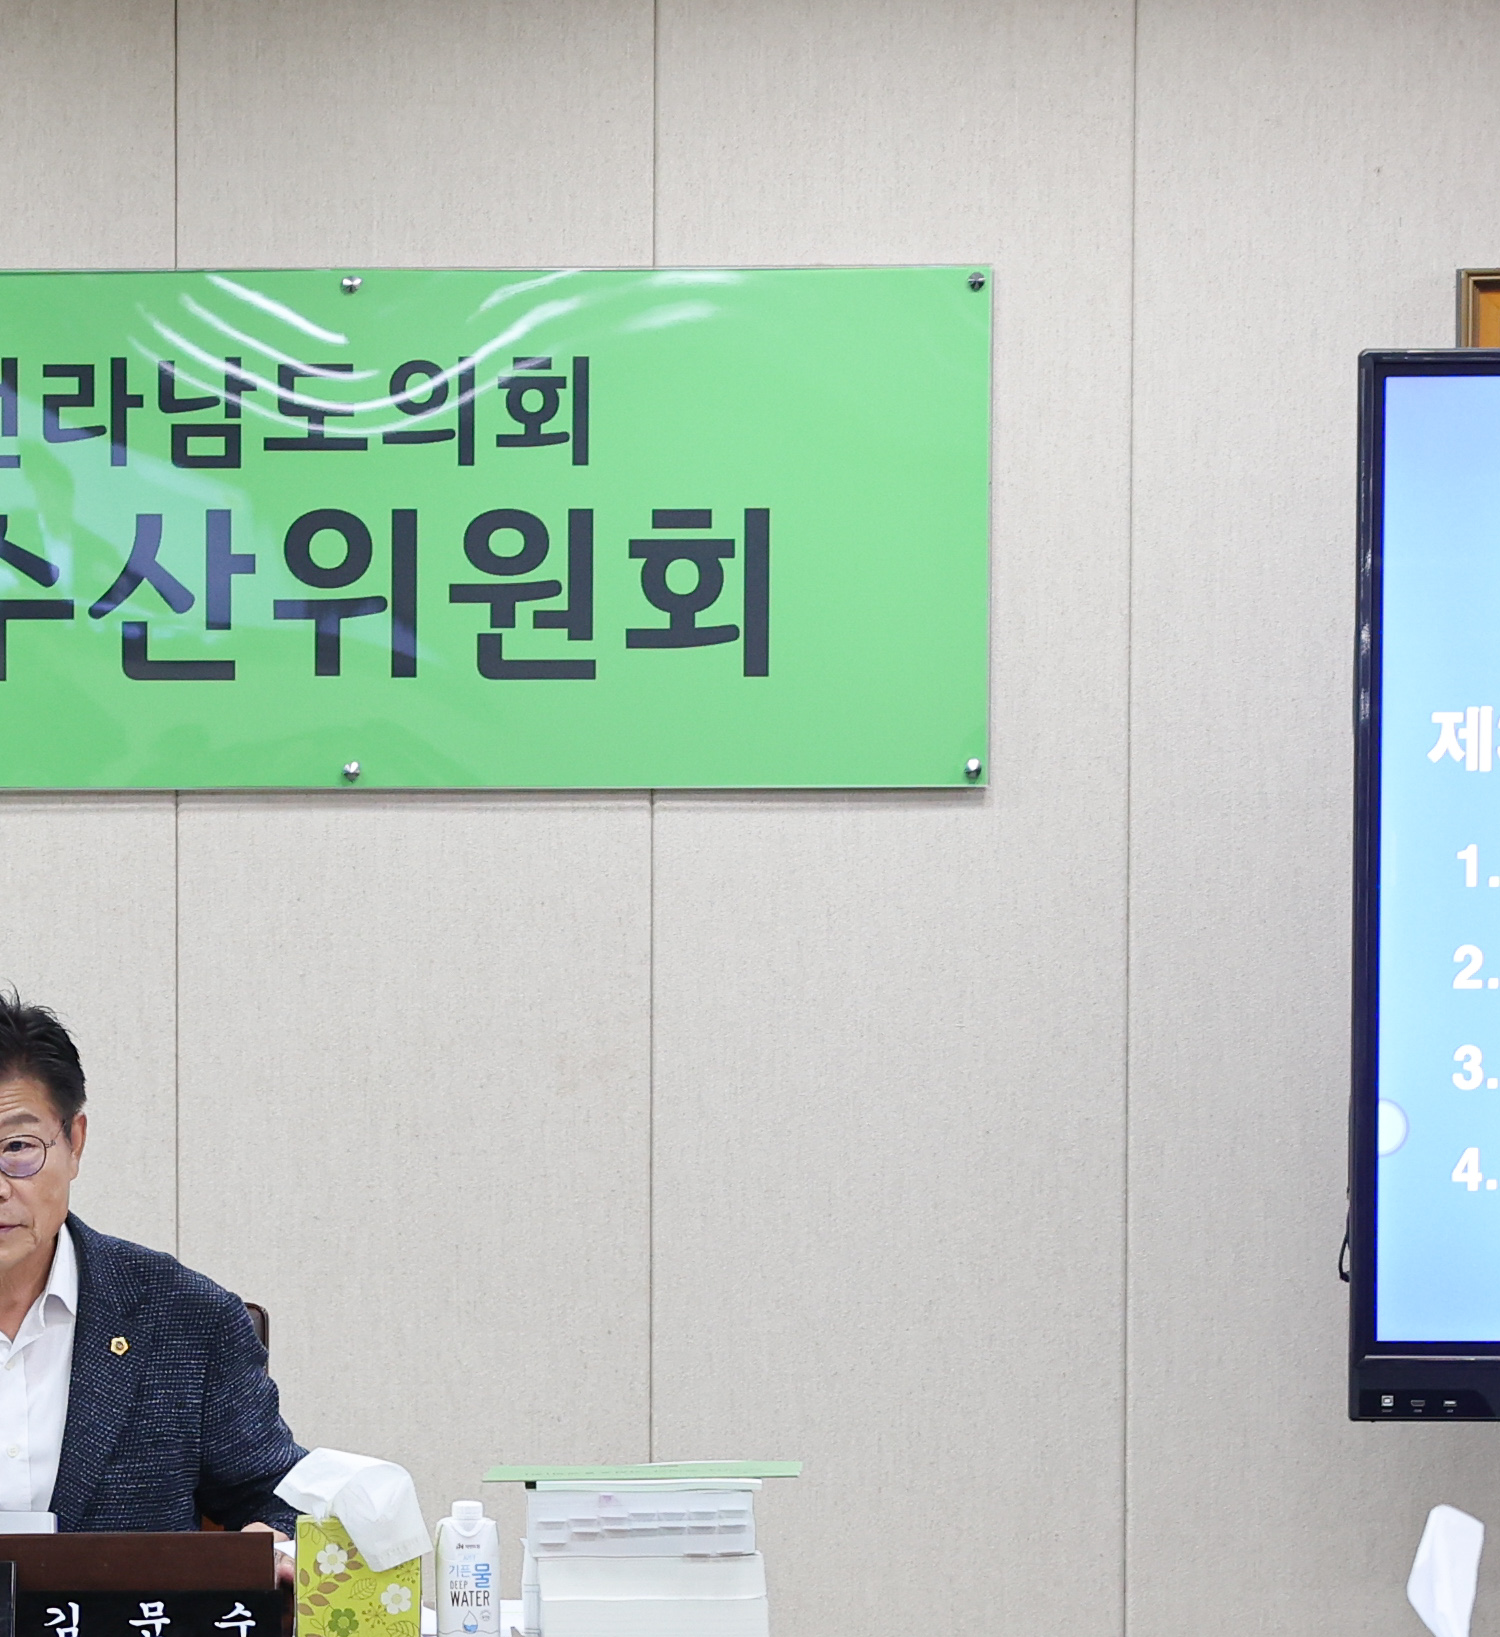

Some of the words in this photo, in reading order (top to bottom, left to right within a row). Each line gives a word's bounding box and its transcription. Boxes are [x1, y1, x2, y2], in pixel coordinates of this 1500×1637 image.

[1457, 843, 1500, 888] 1.
[1453, 944, 1499, 990] 2.
[1452, 1044, 1499, 1091] 3.
[1451, 1147, 1498, 1192] 4.
[450, 1580, 468, 1590] DEEP
[450, 1590, 490, 1607] WATER
[472, 1563, 492, 1589] 물
